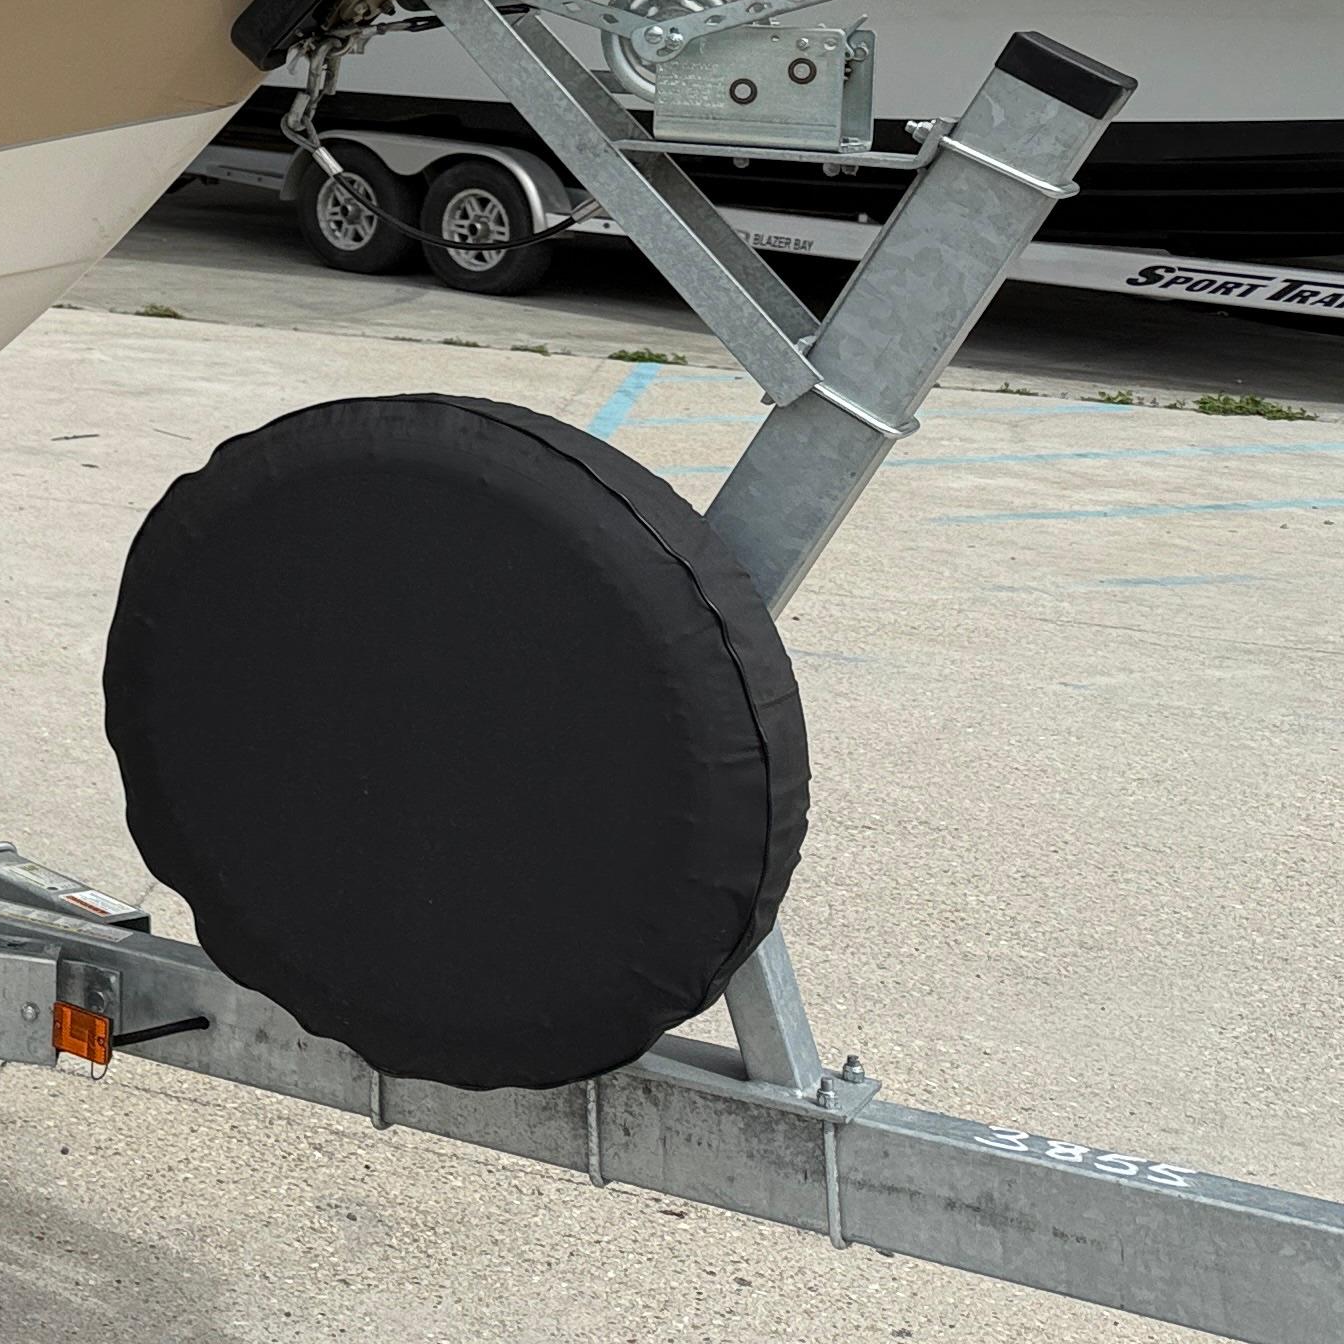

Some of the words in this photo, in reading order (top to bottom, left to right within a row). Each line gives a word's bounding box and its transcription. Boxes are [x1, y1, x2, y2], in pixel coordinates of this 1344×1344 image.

[753, 233, 791, 249] BLAZER
[793, 238, 814, 252] BAY
[1126, 264, 1270, 298] SPORT
[973, 1125, 1198, 1188] 3855
